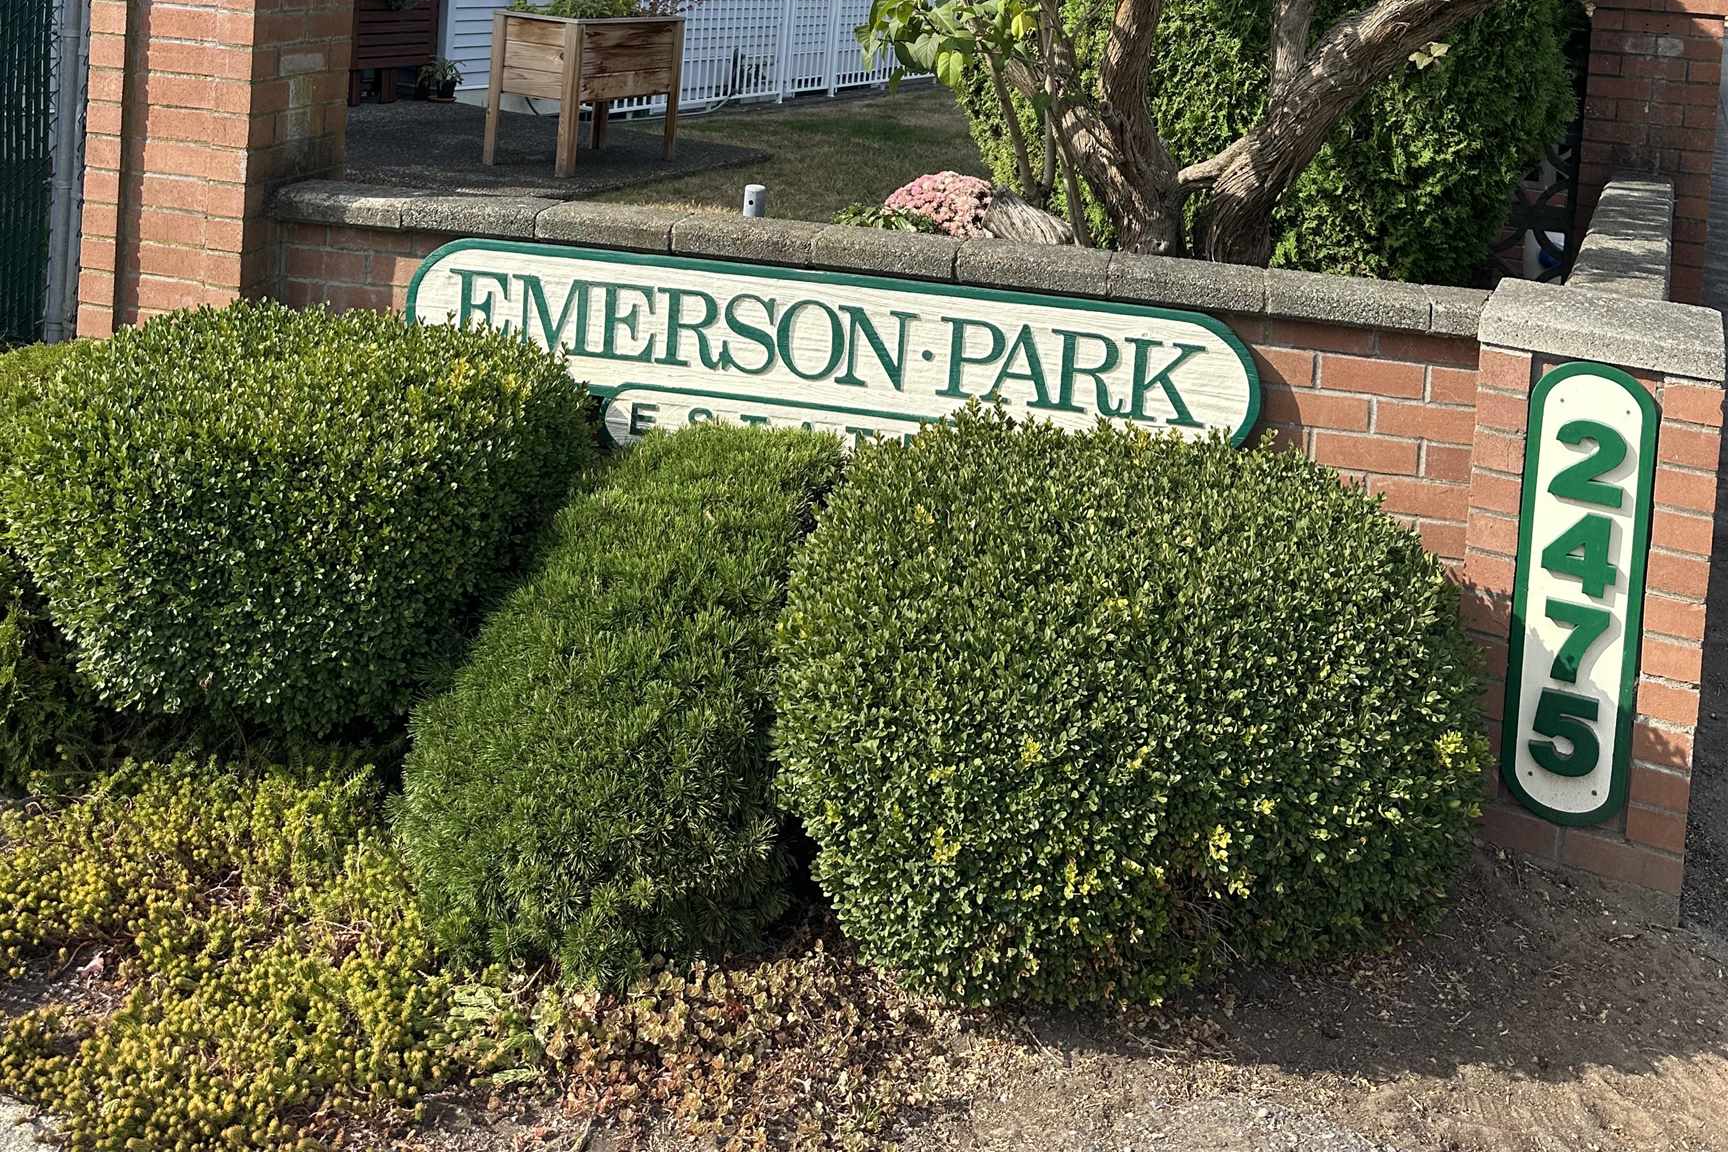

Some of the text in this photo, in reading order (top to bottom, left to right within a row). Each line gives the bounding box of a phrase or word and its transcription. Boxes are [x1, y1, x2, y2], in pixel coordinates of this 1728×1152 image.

[449, 268, 920, 392] EMERSON
[935, 315, 1206, 428] PARK
[1528, 420, 1628, 777] 2475
